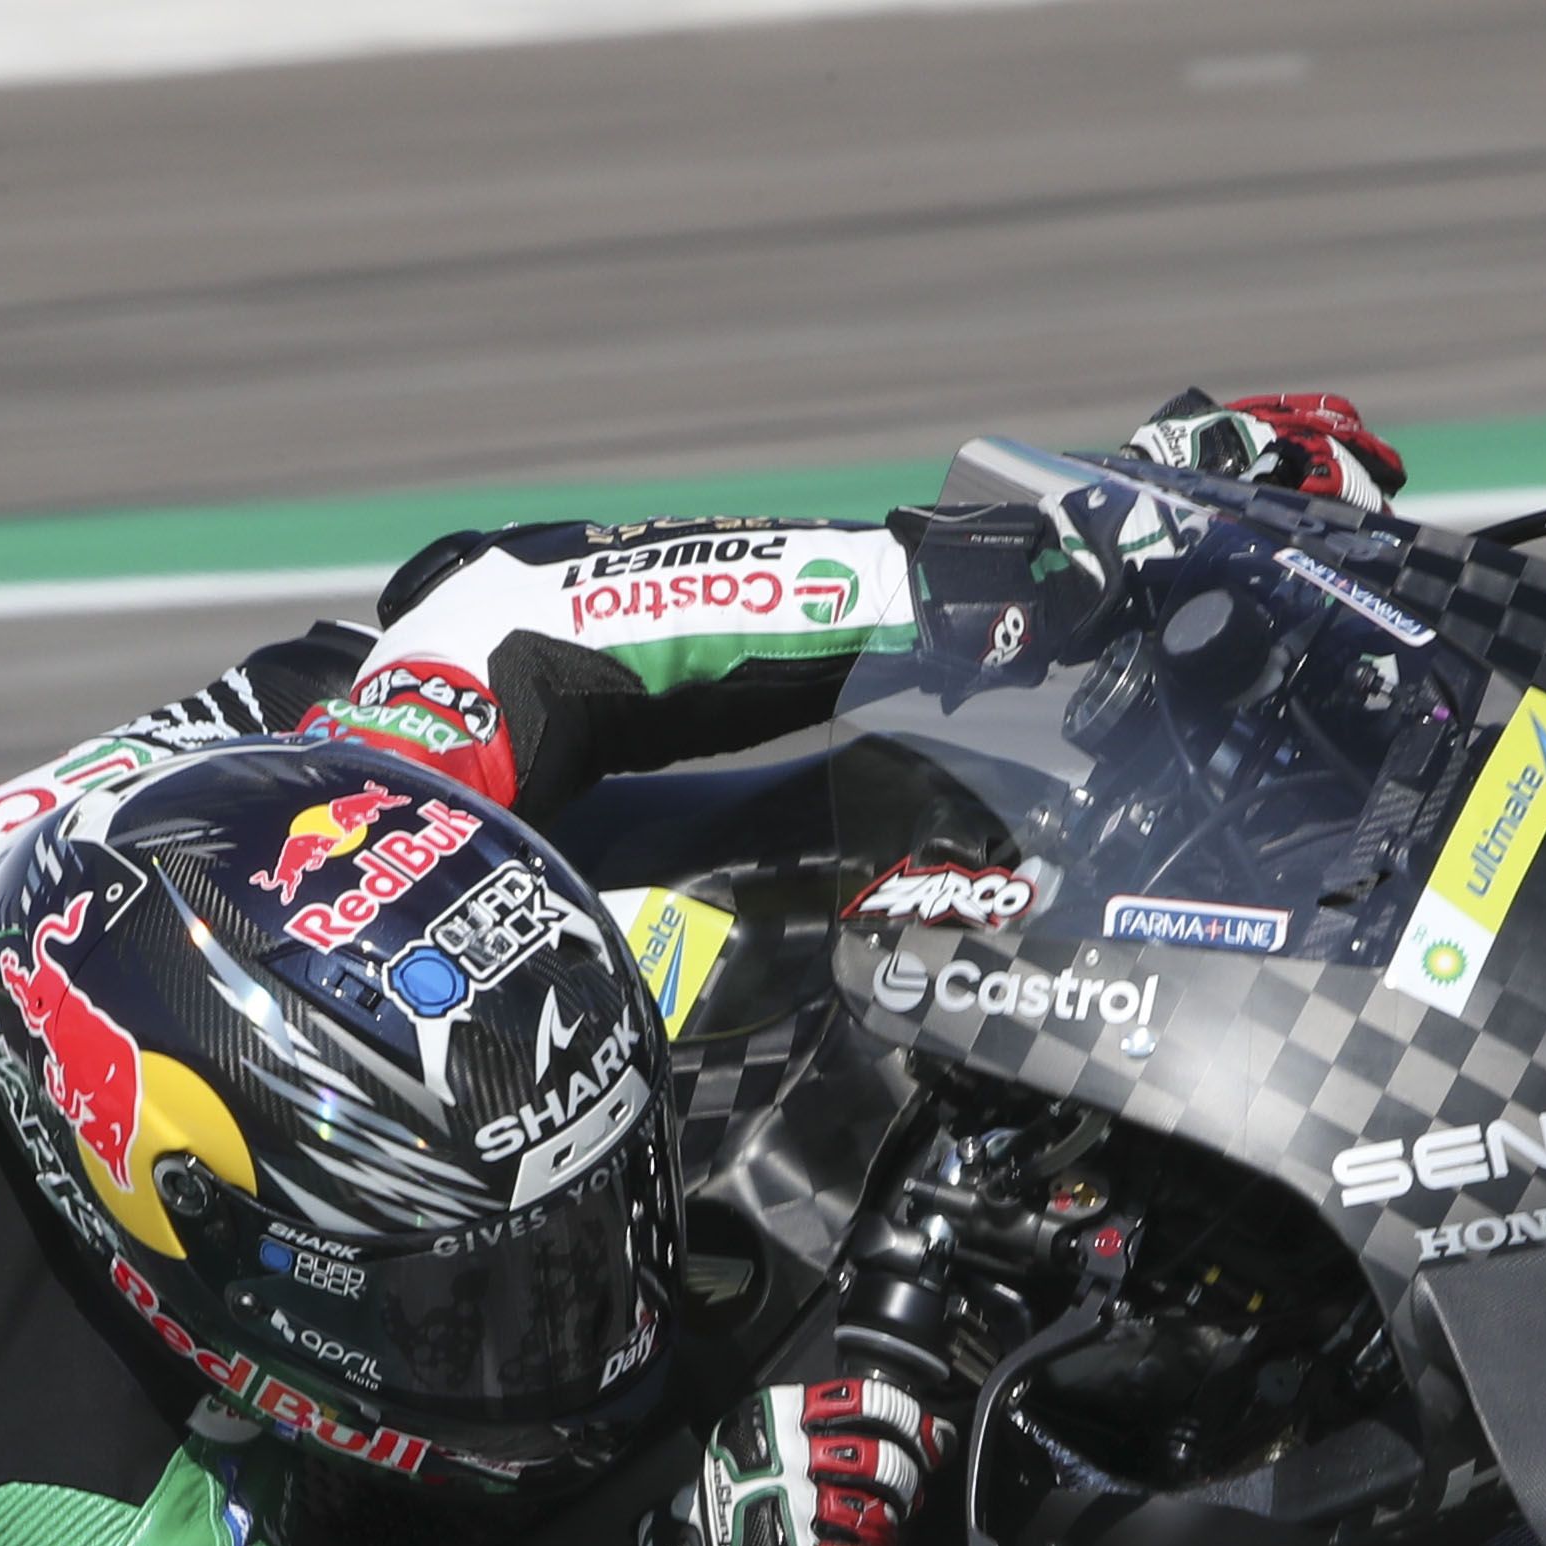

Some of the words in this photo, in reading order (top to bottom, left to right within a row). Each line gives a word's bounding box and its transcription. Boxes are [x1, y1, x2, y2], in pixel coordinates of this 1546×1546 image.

[571, 571, 783, 636] Castrol
[1466, 764, 1545, 899] ultimate
[858, 867, 1033, 929] ZARCO
[935, 957, 1159, 1026] Castrol
[475, 1004, 641, 1164] SHARK
[432, 1205, 549, 1258] GIVES
[570, 1150, 629, 1206] YOU
[267, 1221, 362, 1261] SHARK
[295, 1252, 365, 1284] QUAD
[293, 1267, 360, 1300] LOCK
